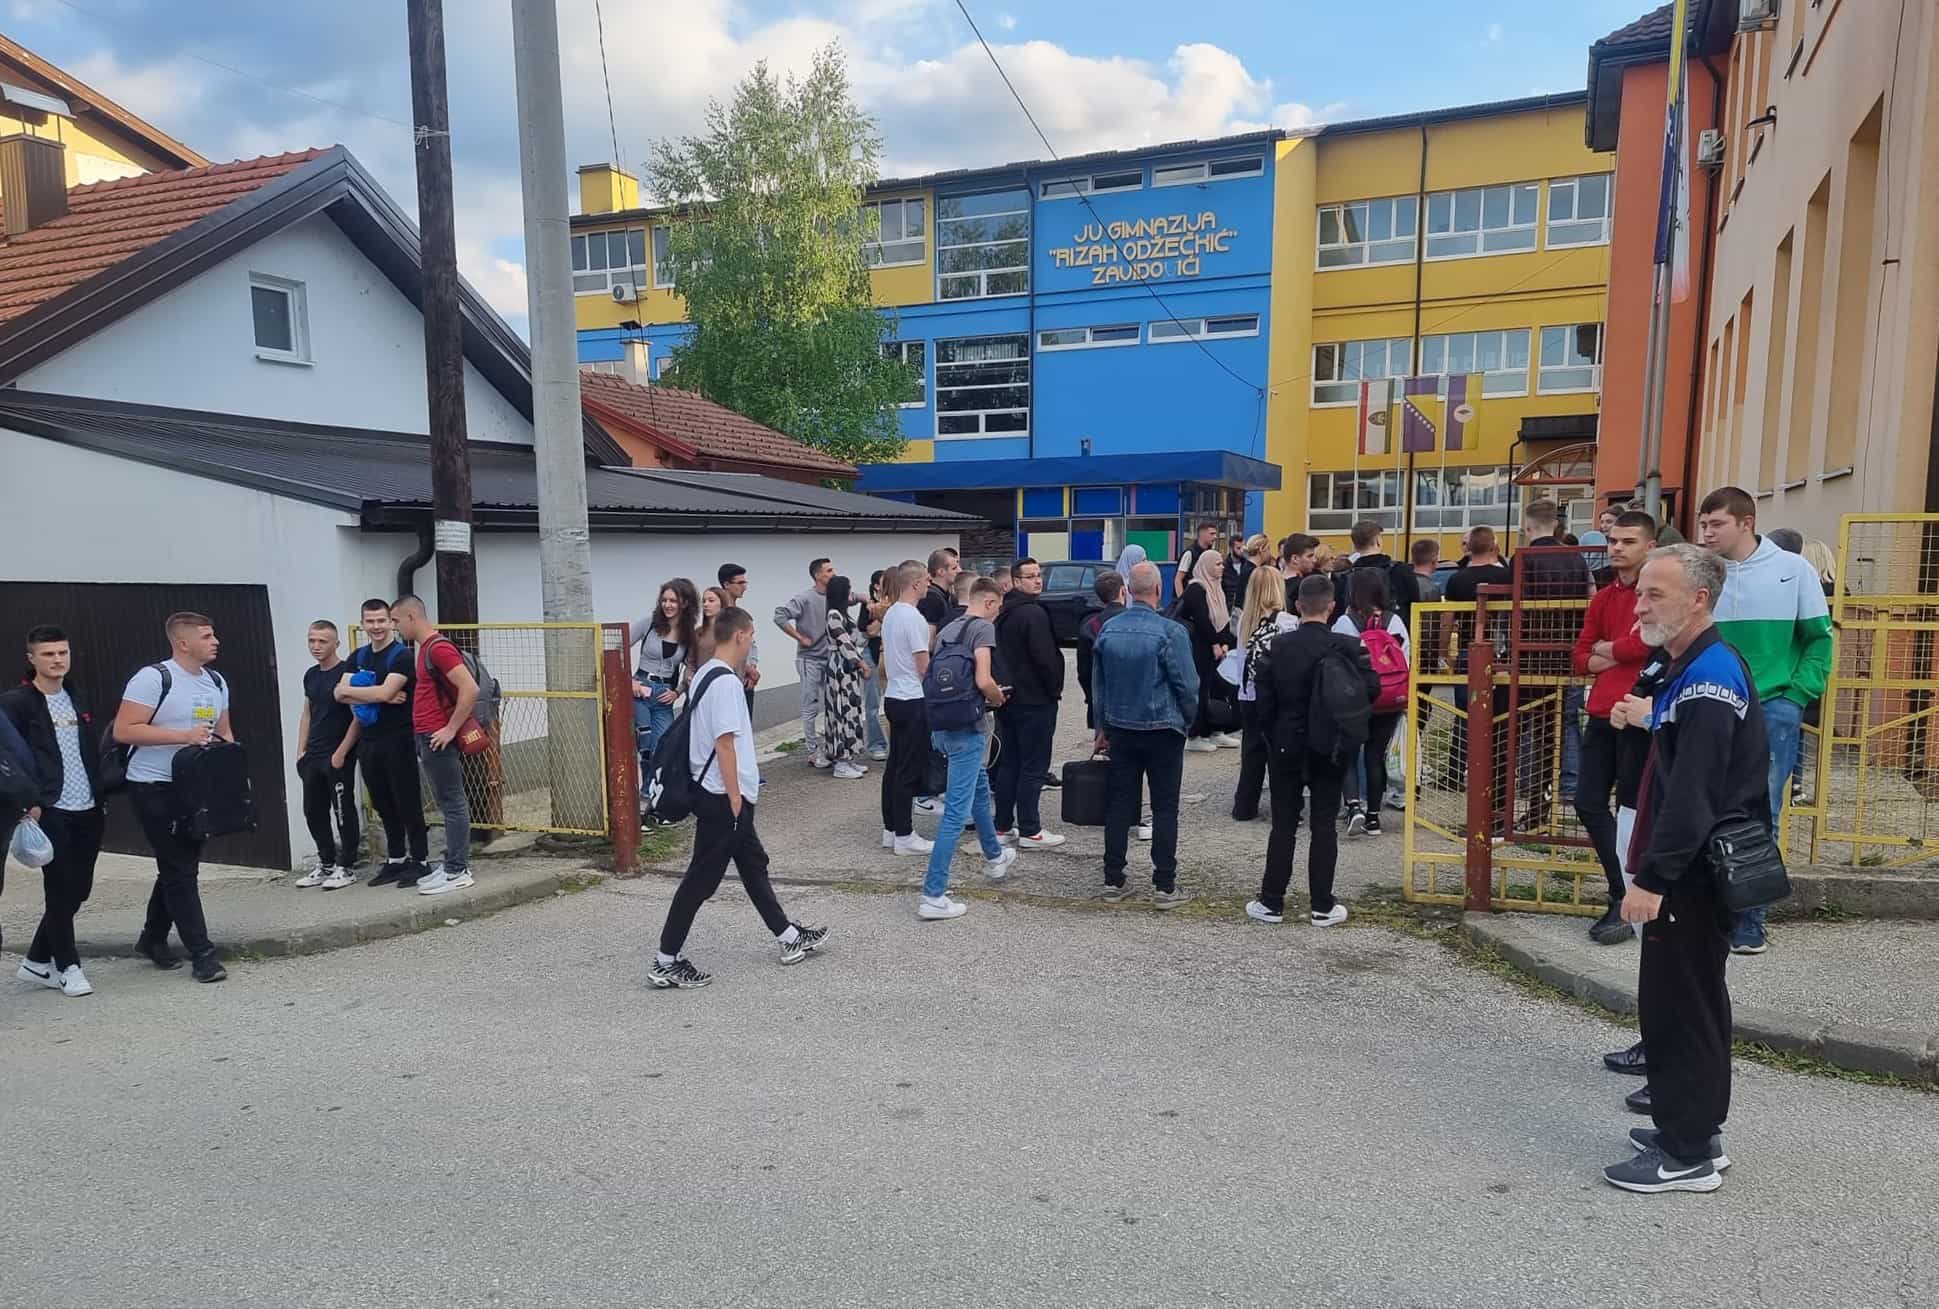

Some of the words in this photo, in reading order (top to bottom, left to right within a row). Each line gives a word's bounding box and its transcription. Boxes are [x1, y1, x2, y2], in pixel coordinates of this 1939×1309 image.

[1074, 224, 1103, 243] JU
[1107, 211, 1216, 240] GIMNAZIJA
[1092, 255, 1200, 284] ZAVIDOIĆI
